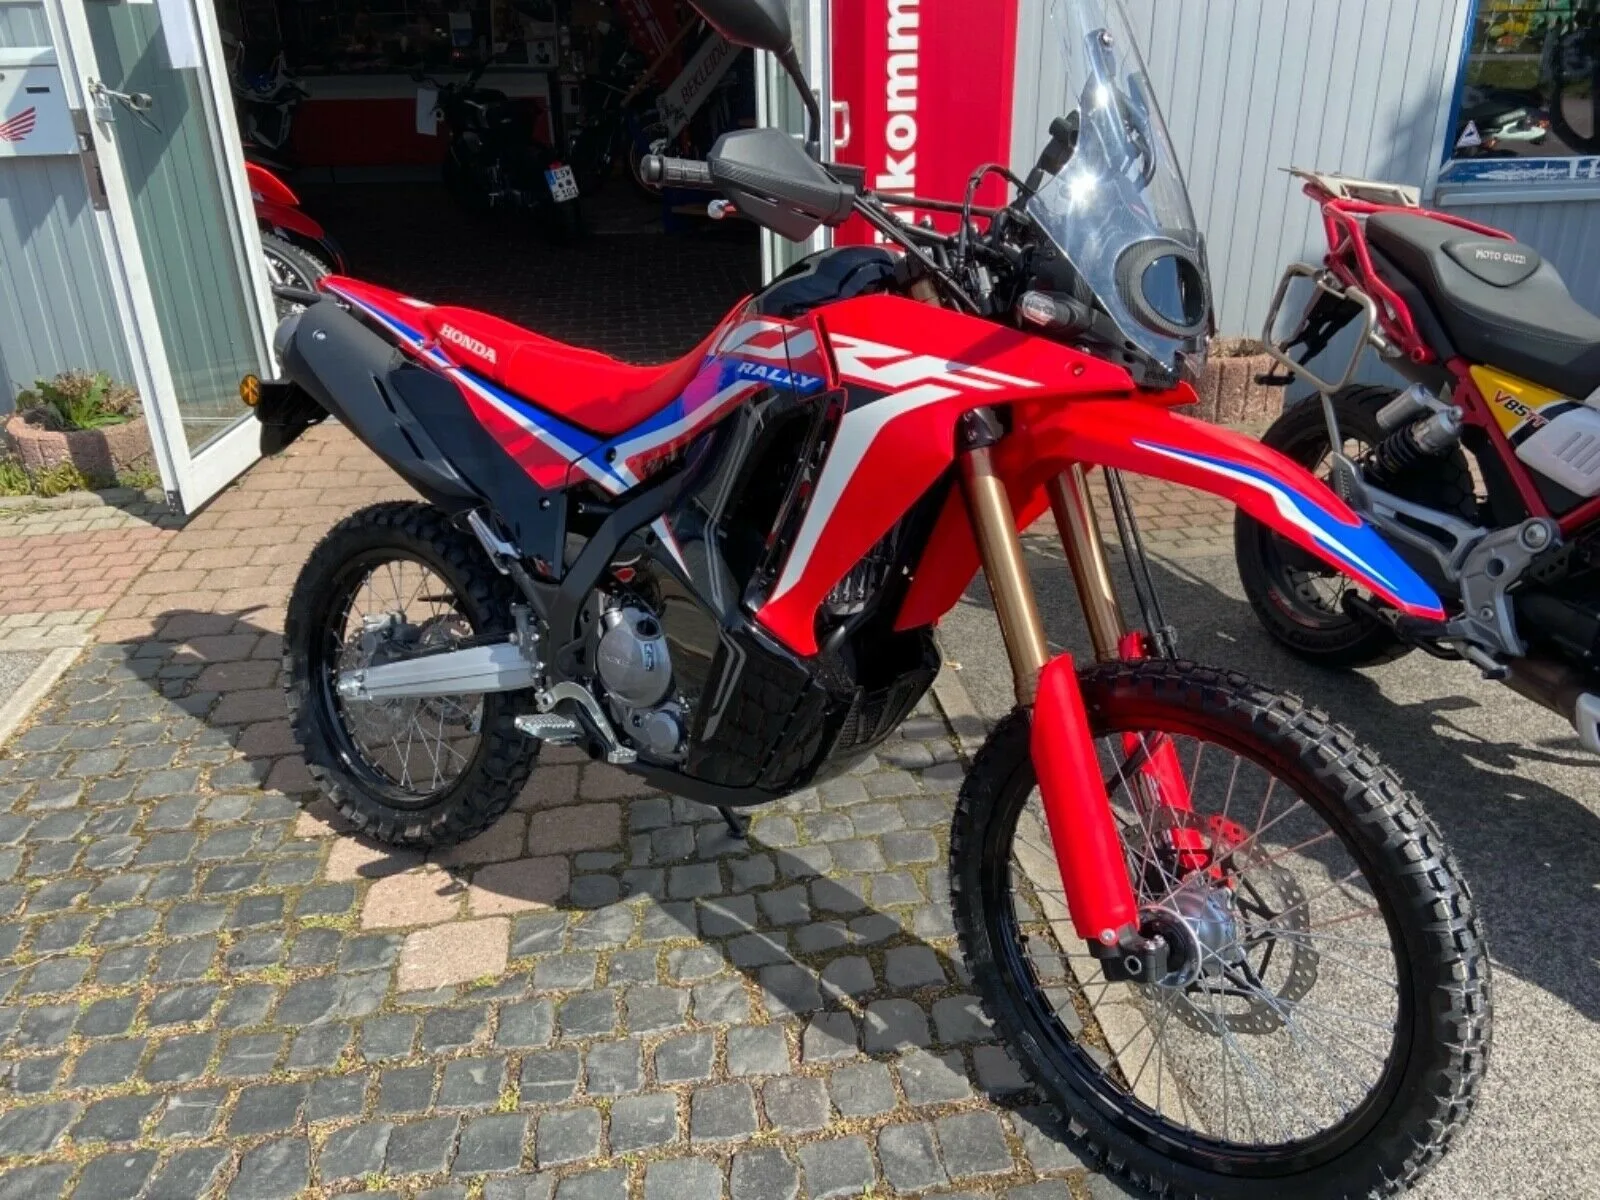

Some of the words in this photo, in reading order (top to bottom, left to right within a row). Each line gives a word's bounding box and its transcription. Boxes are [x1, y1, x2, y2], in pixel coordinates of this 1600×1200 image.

[1475, 249, 1501, 261] MOTO
[1502, 253, 1526, 265] GUZZI
[439, 323, 497, 365] HONDA
[737, 361, 820, 388] RALLY
